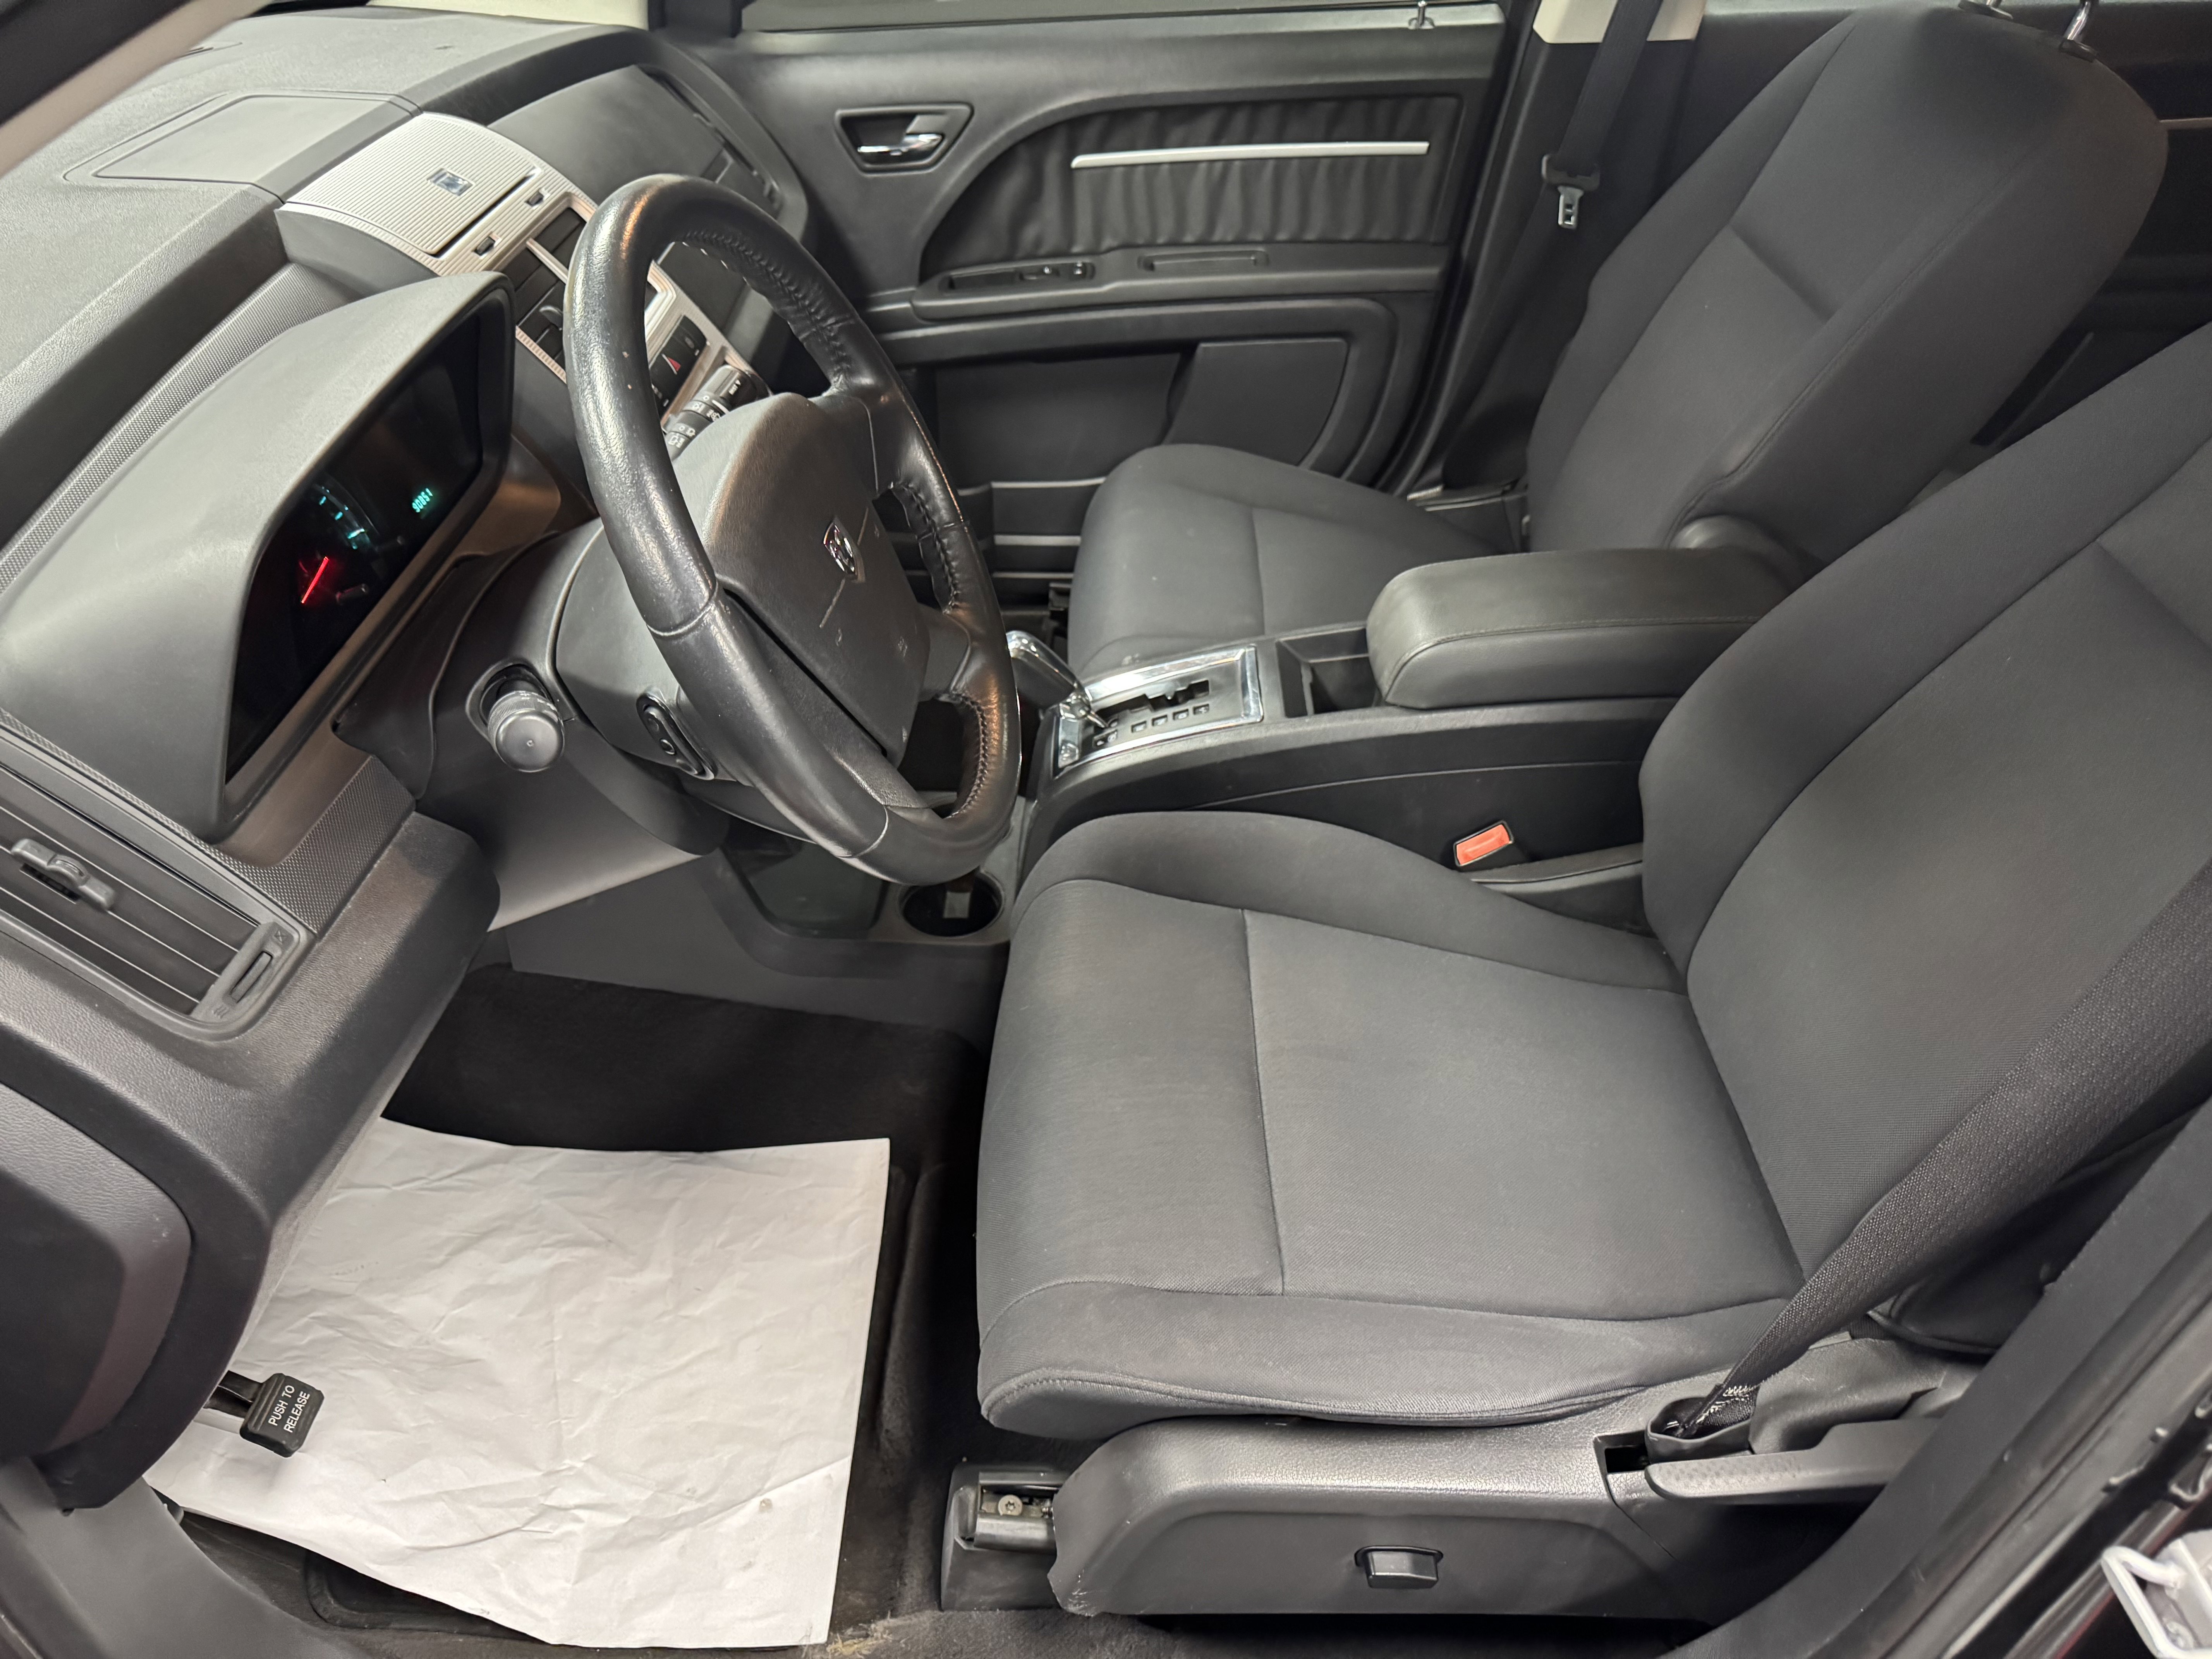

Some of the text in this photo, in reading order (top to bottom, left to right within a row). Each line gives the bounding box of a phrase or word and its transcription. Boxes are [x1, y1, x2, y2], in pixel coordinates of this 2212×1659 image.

[412, 488, 433, 512] 90851
[268, 1385, 295, 1426] PUSH TO
[283, 1391, 310, 1432] RELEASE
